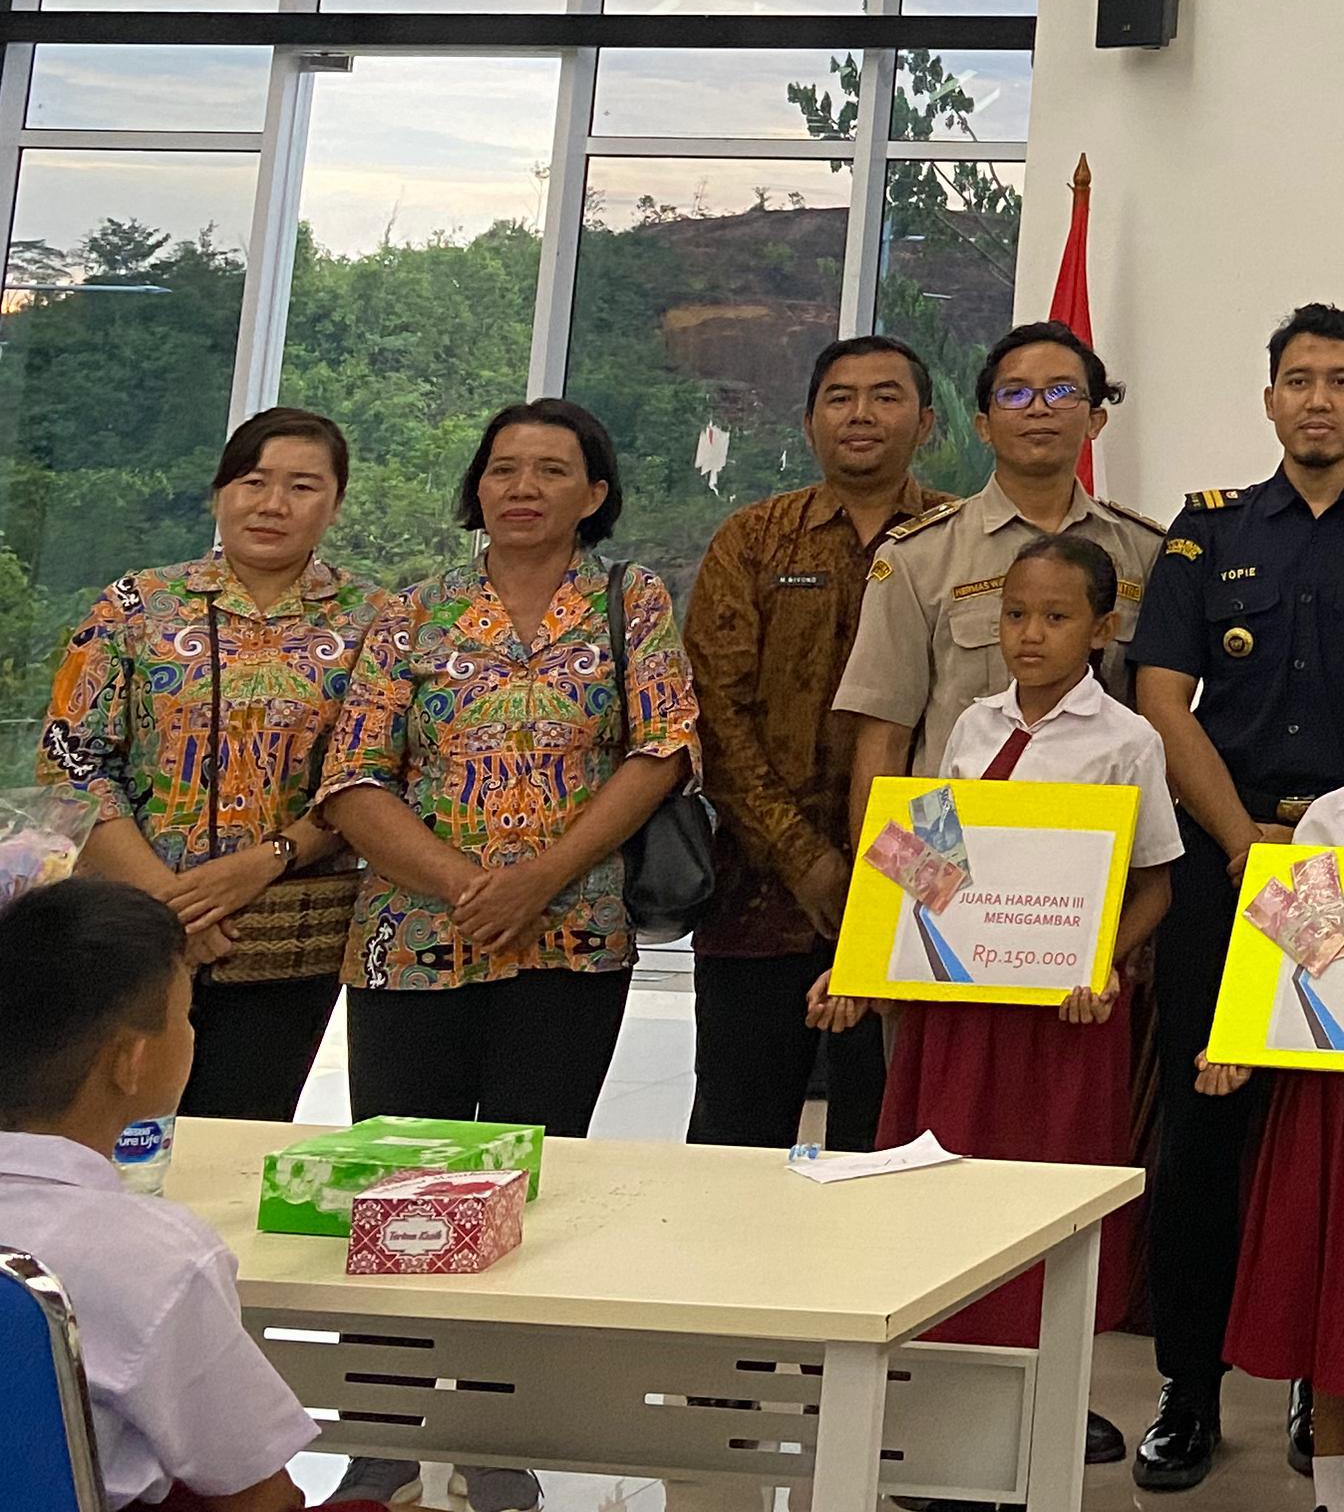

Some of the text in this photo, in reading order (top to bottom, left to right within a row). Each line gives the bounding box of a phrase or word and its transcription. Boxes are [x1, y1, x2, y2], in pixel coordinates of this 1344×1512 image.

[1220, 567, 1256, 582] YOPIE
[959, 892, 1085, 909] JUARA HARAPAN III
[983, 911, 1081, 928] MENGGAMBAR
[972, 943, 1079, 970] Rp.150.000
[117, 1134, 161, 1150] ure Life
